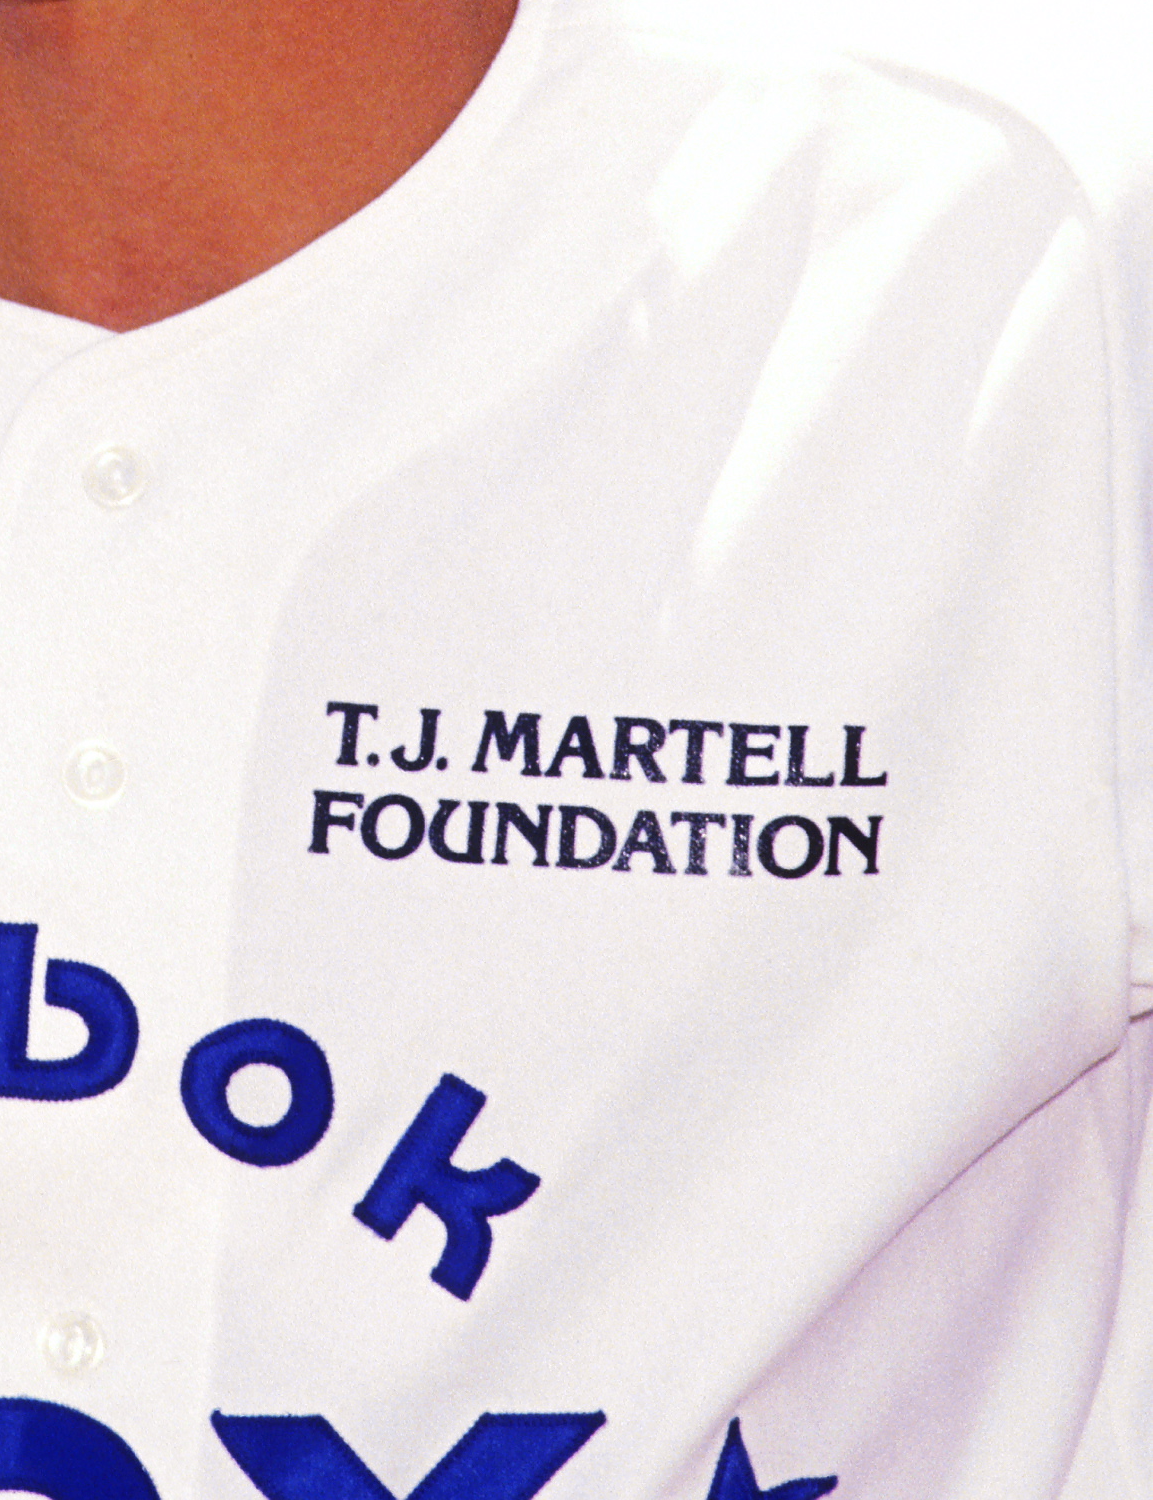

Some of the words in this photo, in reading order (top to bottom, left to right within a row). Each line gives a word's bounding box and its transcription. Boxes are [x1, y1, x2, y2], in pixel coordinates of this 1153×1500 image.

[326, 701, 448, 772] T.J.
[471, 710, 888, 787] MARTELL
[307, 789, 885, 879] FOUNDATION
